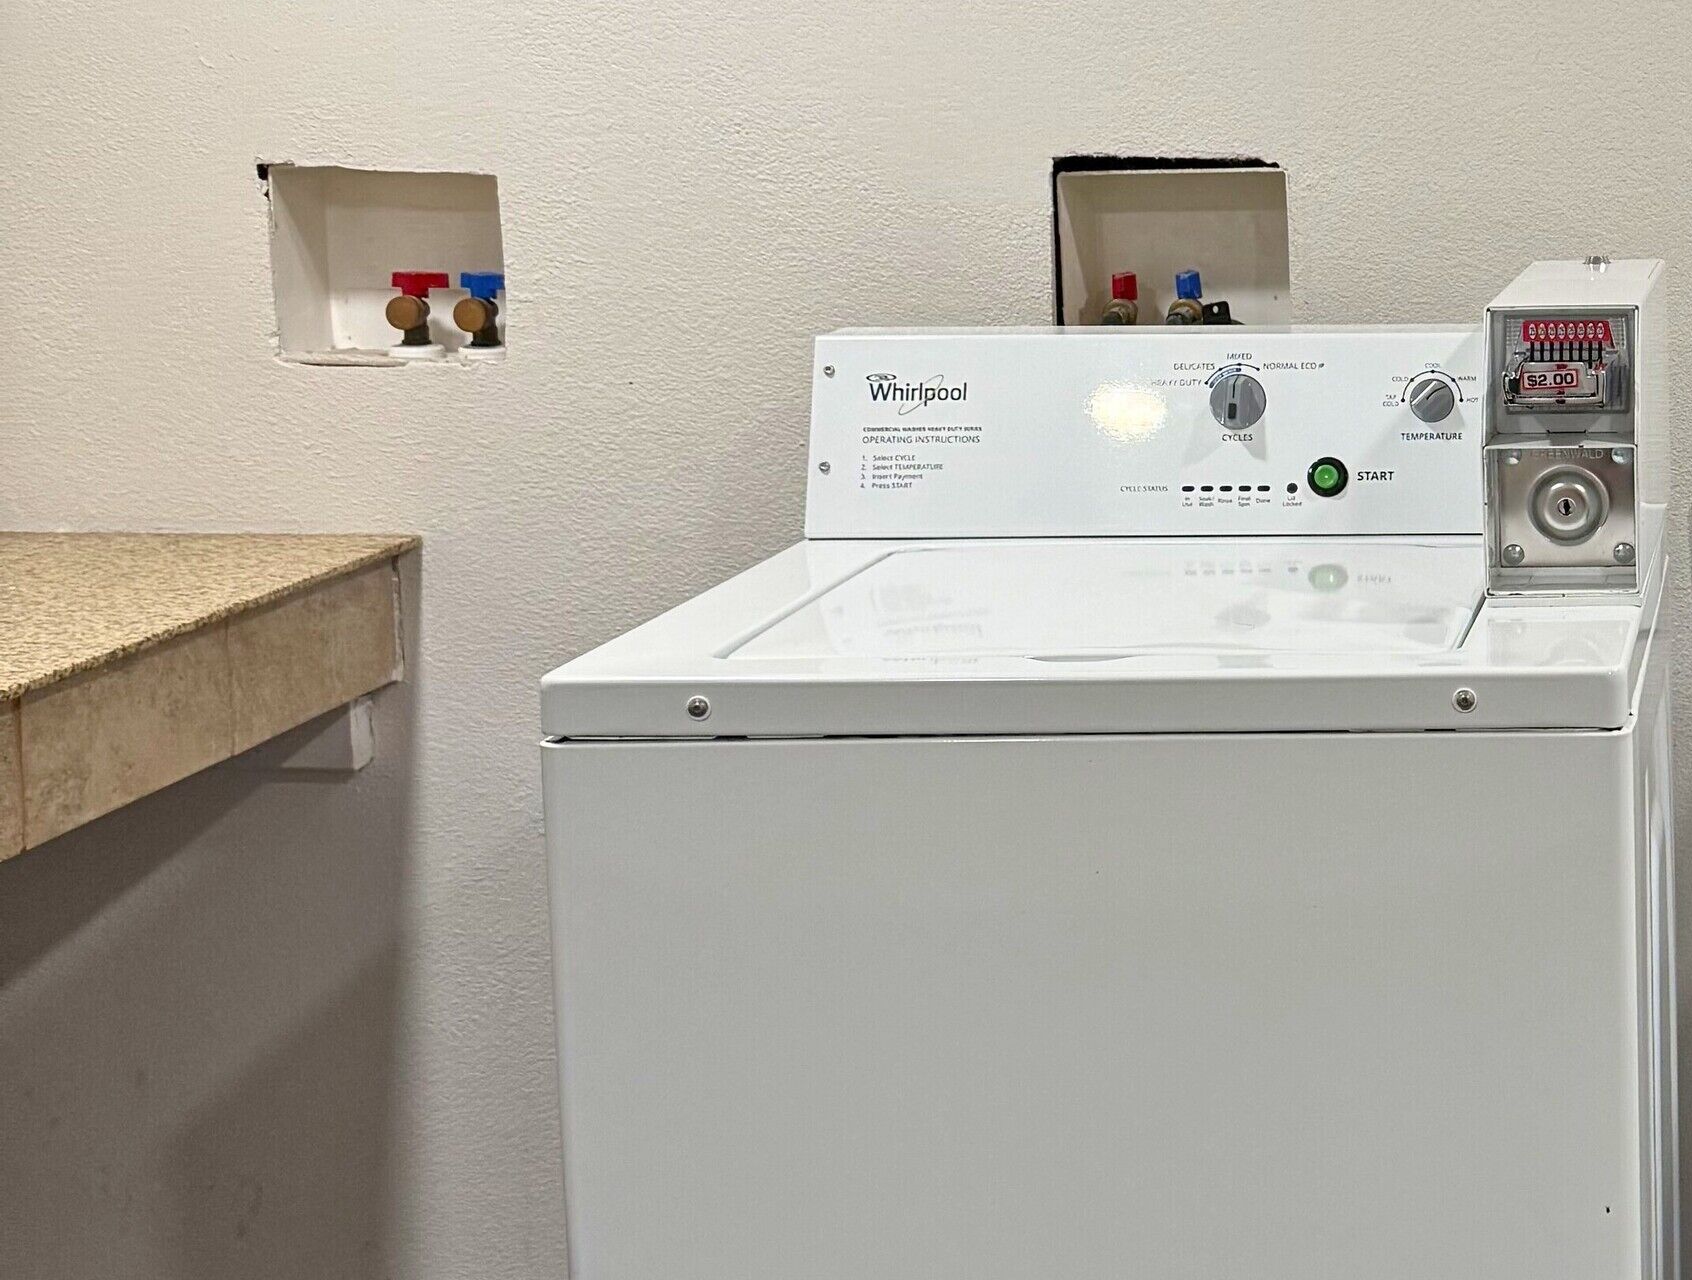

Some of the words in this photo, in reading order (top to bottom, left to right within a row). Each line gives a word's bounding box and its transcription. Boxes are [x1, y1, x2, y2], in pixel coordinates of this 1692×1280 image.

[1263, 362, 1298, 370] NORMAL
[1301, 362, 1317, 370] ECO
[1527, 373, 1574, 387] $2.00
[869, 382, 967, 407] Whirlpool
[862, 435, 912, 444] OPERATING
[915, 435, 980, 444] INSTRUCTIONS
[1222, 433, 1253, 441] CYCLES
[1401, 432, 1463, 441] TEMPERATURE
[1357, 471, 1394, 481] START
